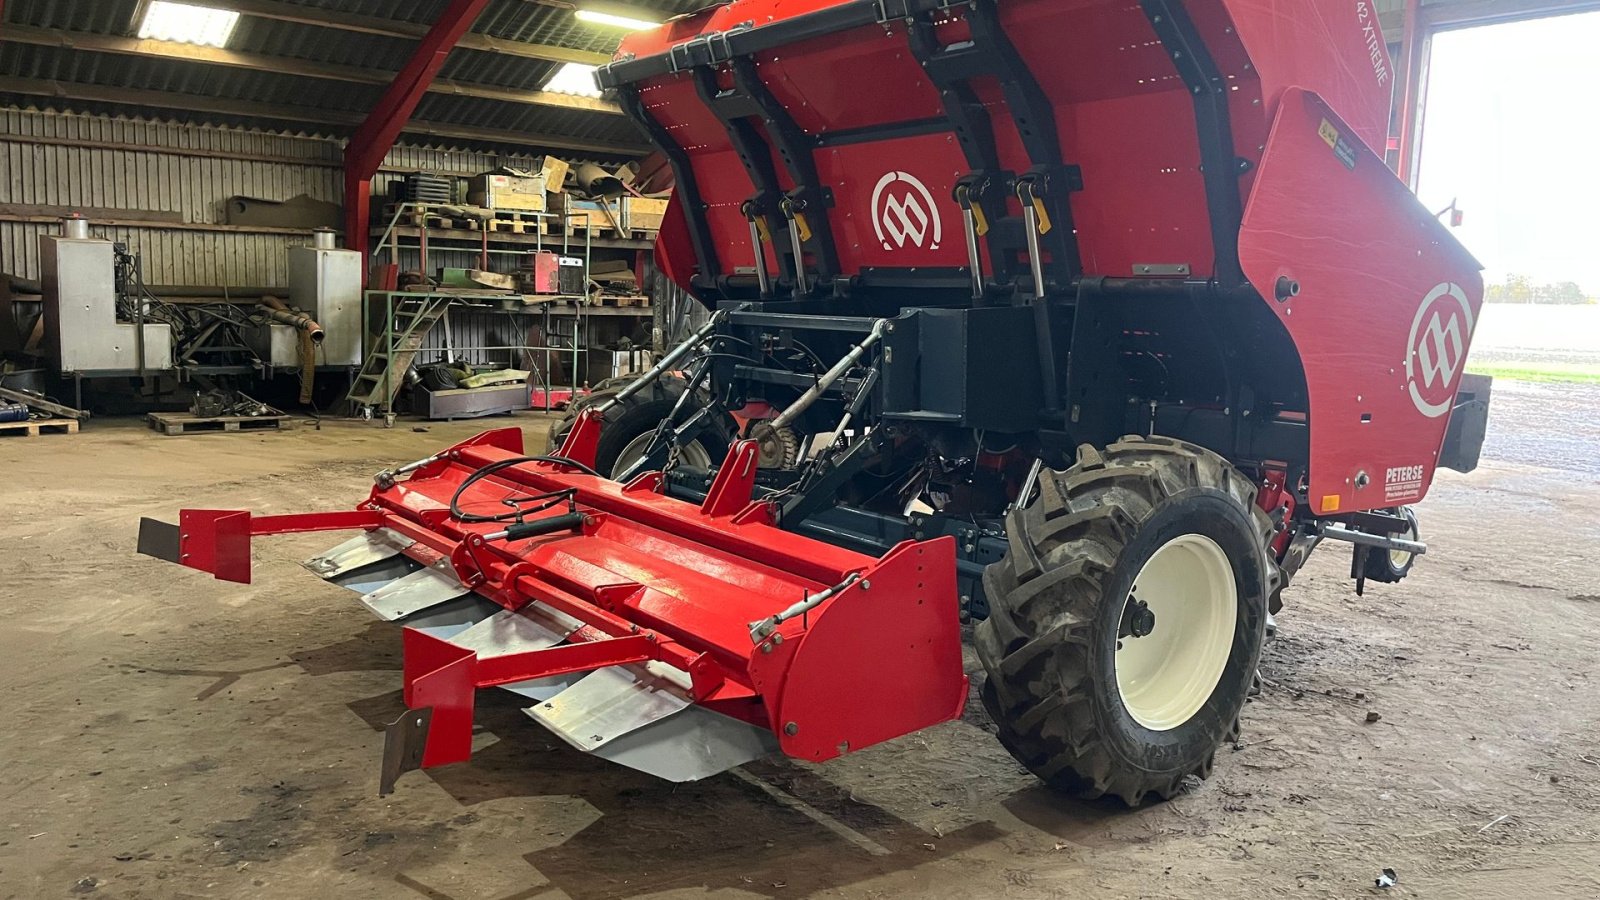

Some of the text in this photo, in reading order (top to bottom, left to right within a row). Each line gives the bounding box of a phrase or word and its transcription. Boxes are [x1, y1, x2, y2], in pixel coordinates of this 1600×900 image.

[1357, 2, 1388, 87] 42 XTREME
[1385, 465, 1424, 483] PETERSE
